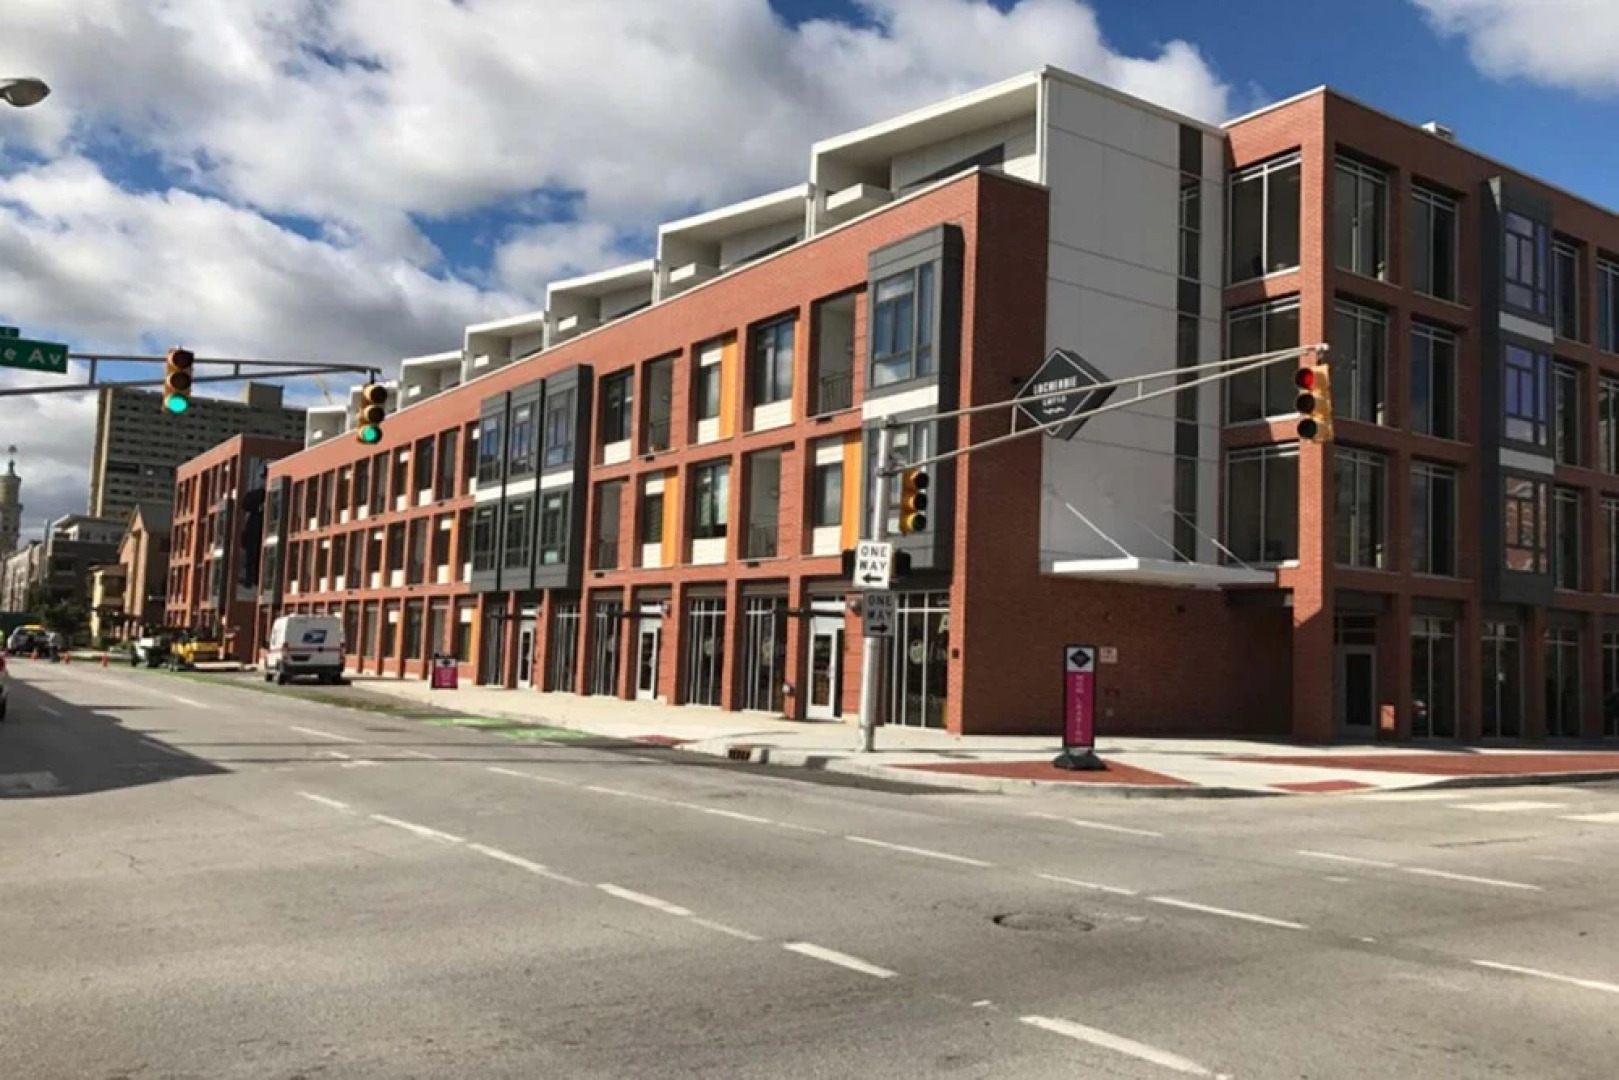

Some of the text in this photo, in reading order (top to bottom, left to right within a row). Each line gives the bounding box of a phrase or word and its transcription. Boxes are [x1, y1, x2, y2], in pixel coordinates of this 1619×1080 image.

[28, 348, 61, 365] Av
[861, 545, 887, 557] ONE
[860, 560, 887, 571] WAY
[868, 594, 892, 605] ONE
[868, 610, 892, 620] WAY
